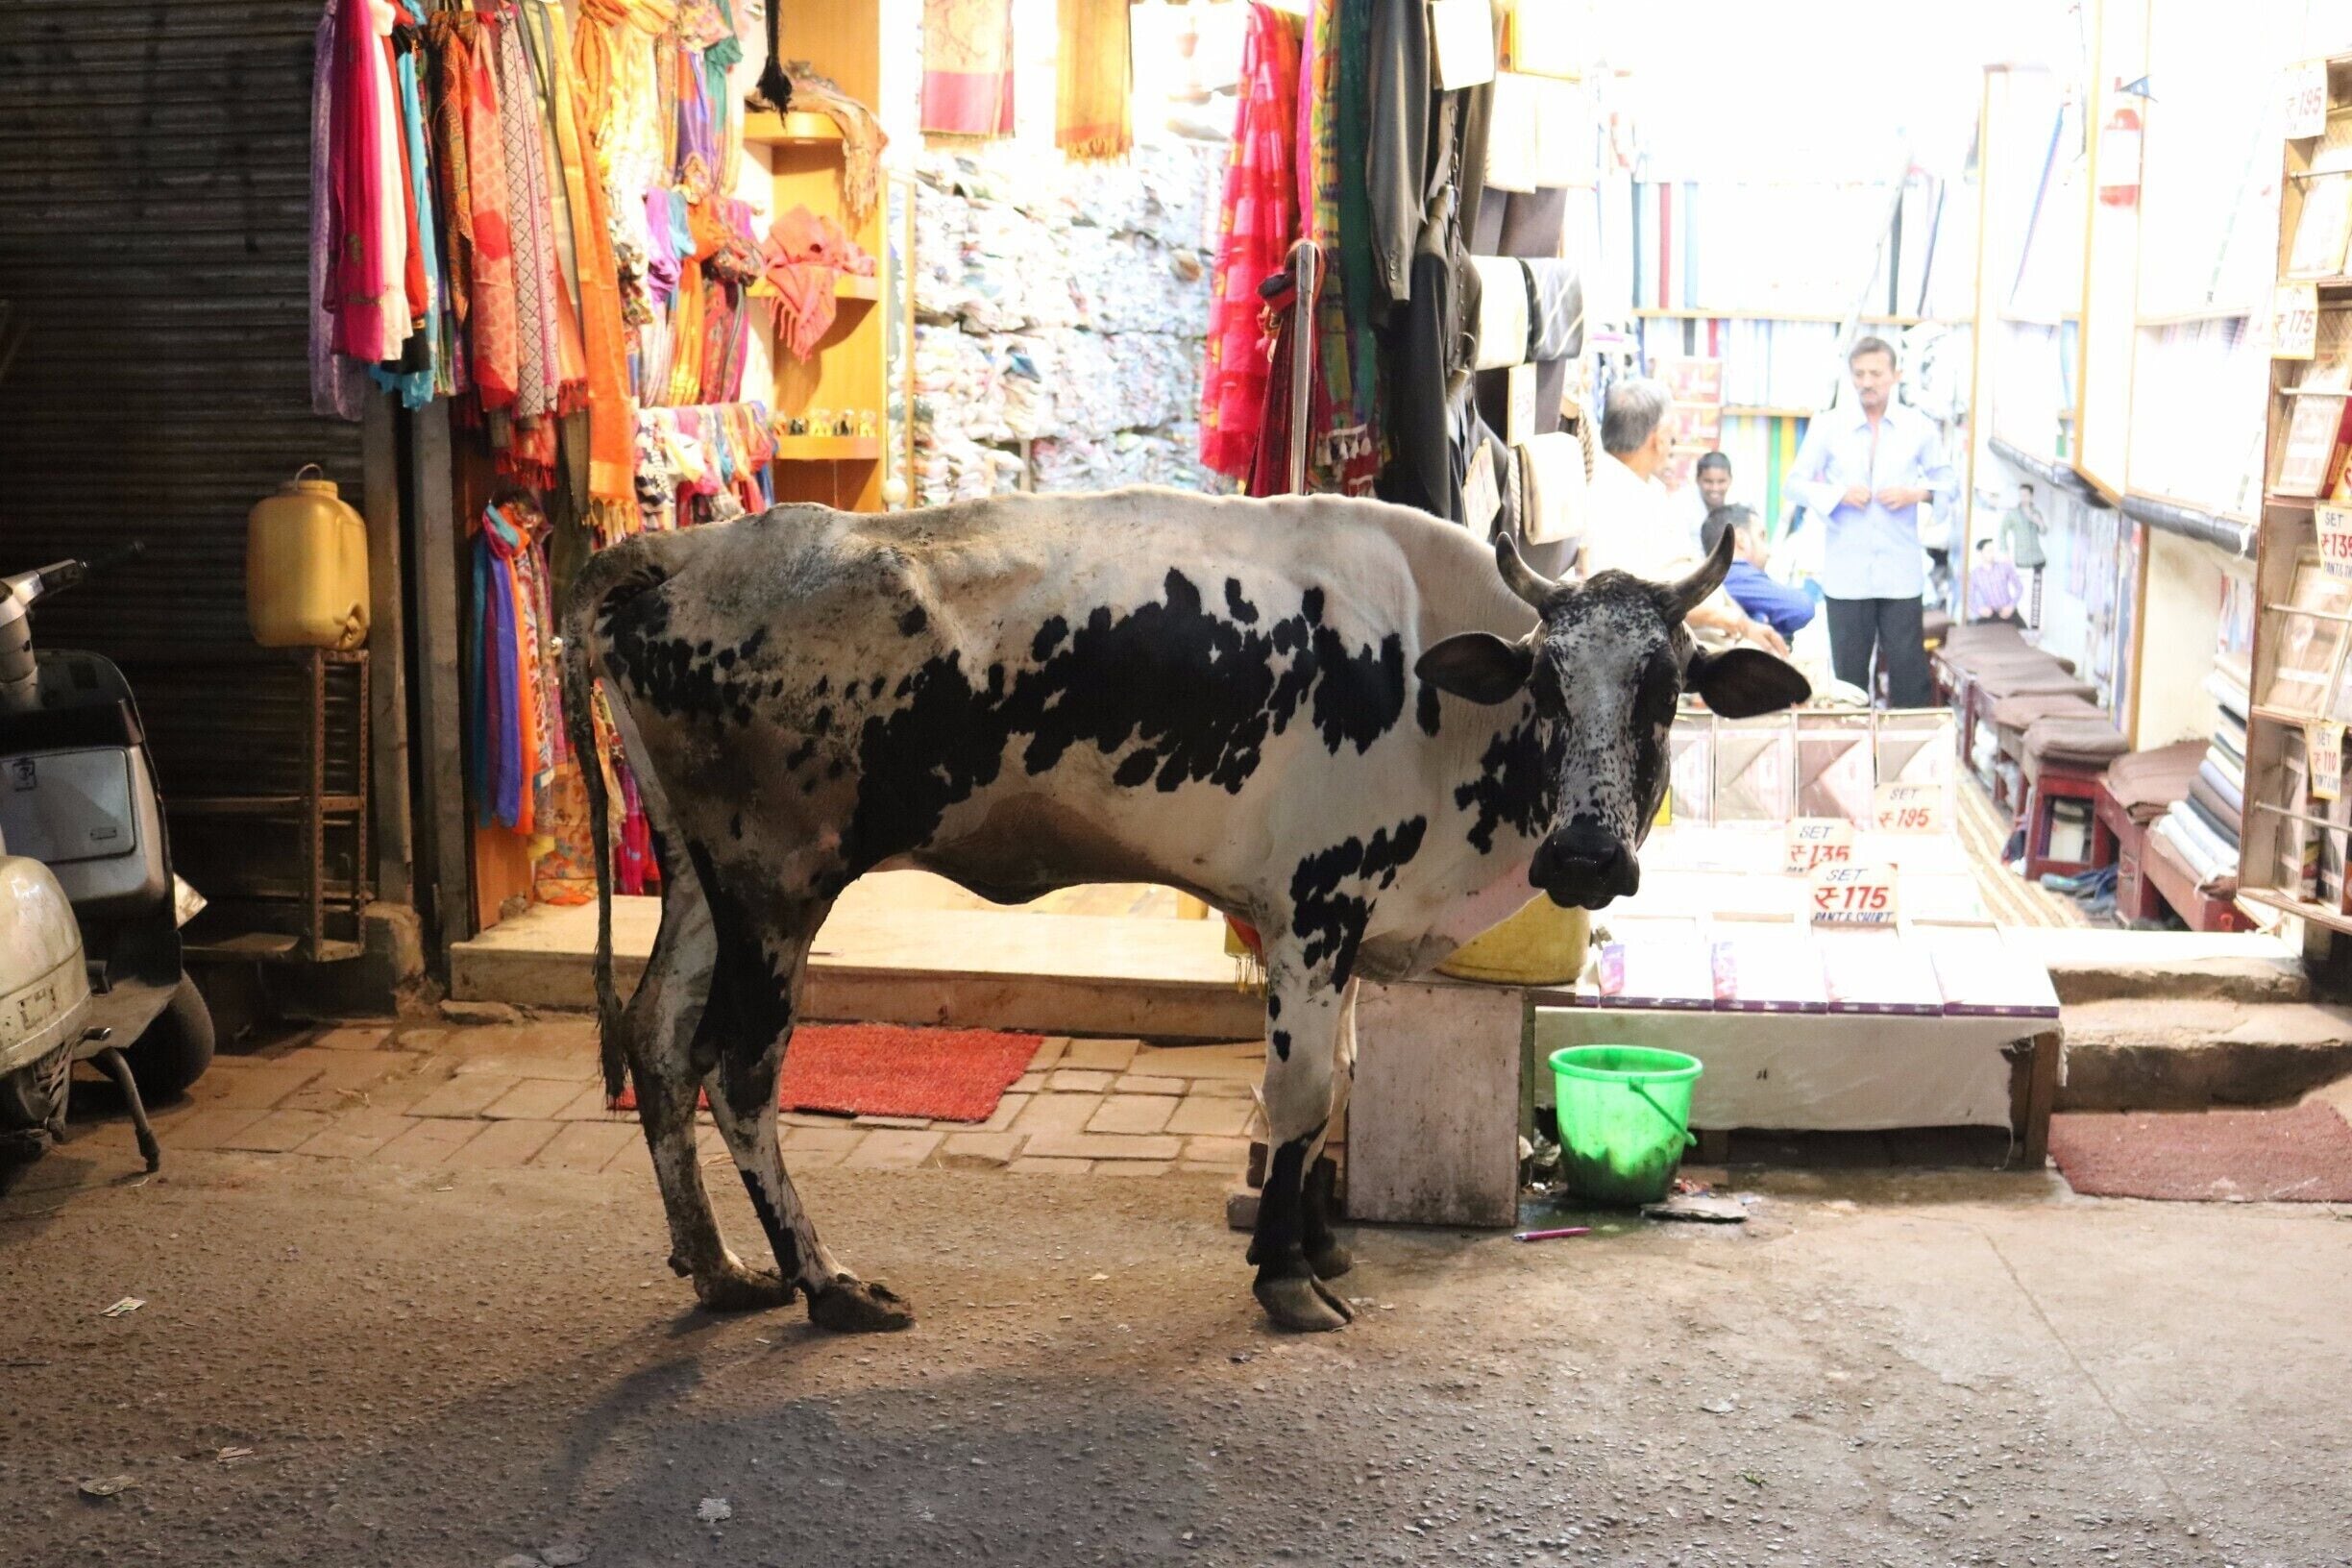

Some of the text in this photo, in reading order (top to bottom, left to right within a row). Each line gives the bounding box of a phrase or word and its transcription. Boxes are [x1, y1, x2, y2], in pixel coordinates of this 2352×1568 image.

[2324, 512, 2344, 527] SET
[1889, 787, 1921, 800] SET
[1799, 825, 1834, 839] SET
[1825, 868, 1868, 881] SET
